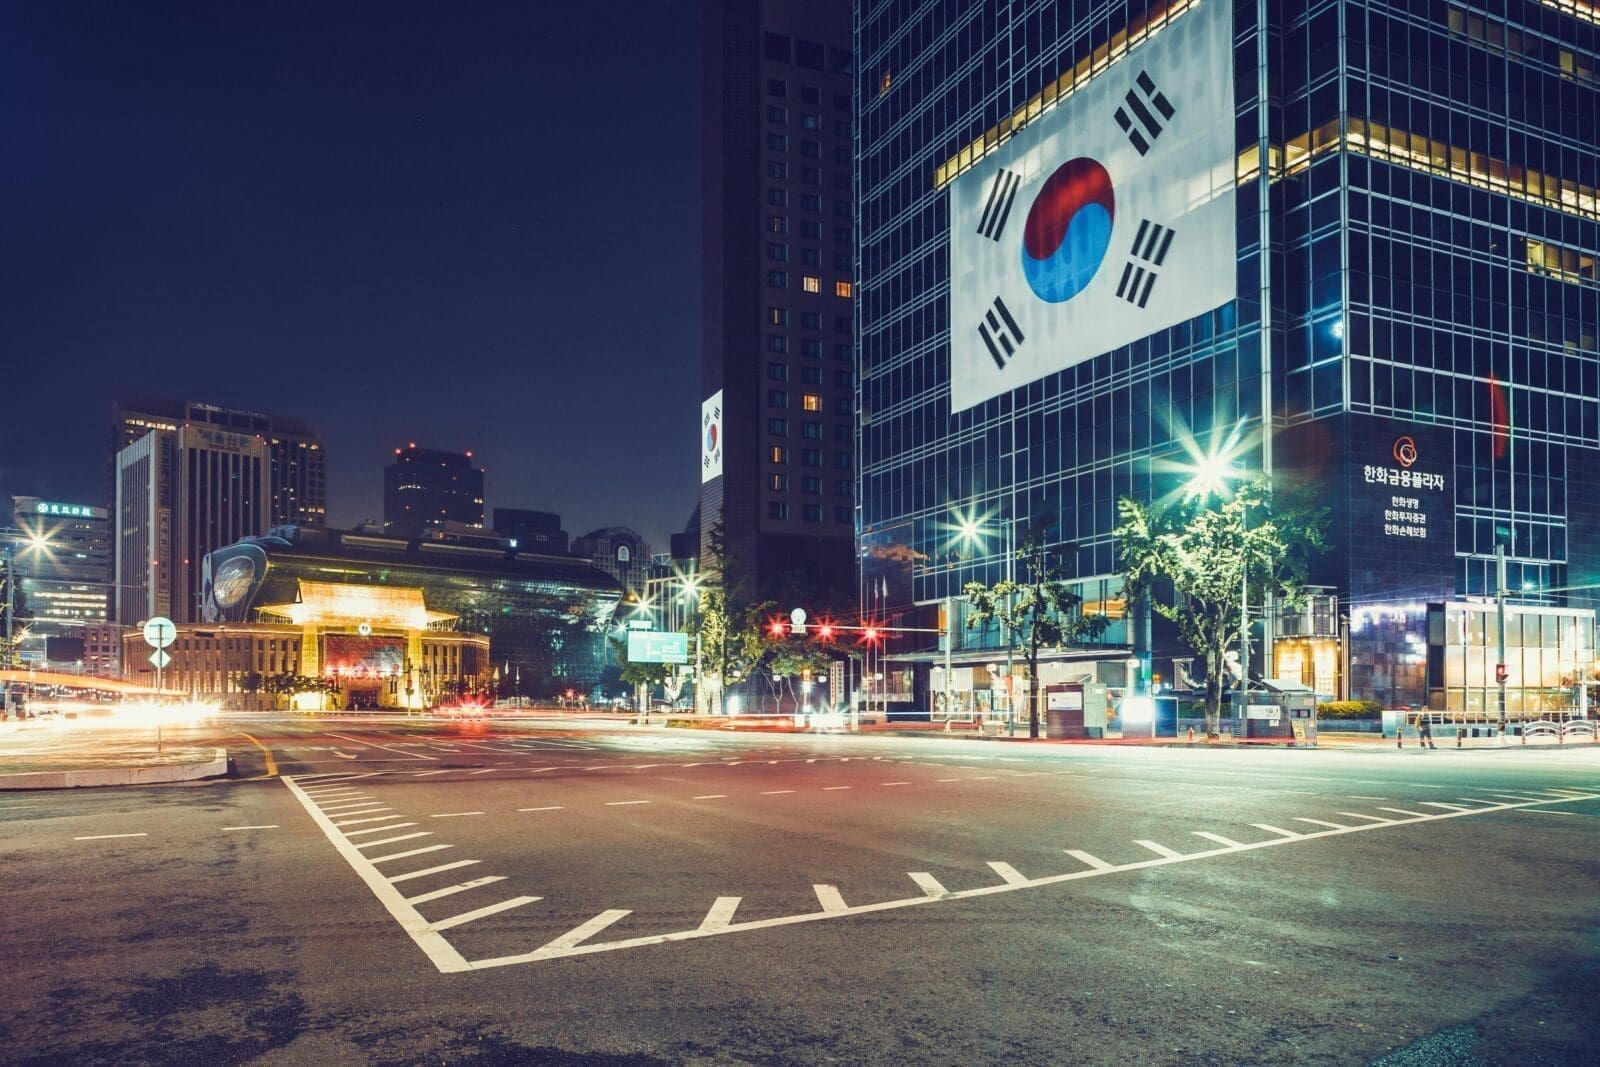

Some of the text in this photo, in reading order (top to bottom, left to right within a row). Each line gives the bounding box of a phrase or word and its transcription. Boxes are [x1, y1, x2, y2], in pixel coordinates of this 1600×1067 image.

[1363, 465, 1445, 491] 한화금융플라자
[1391, 496, 1419, 509] 한화생명
[1384, 509, 1426, 524] 한화투자증권
[1384, 524, 1427, 538] 한화손해보험
